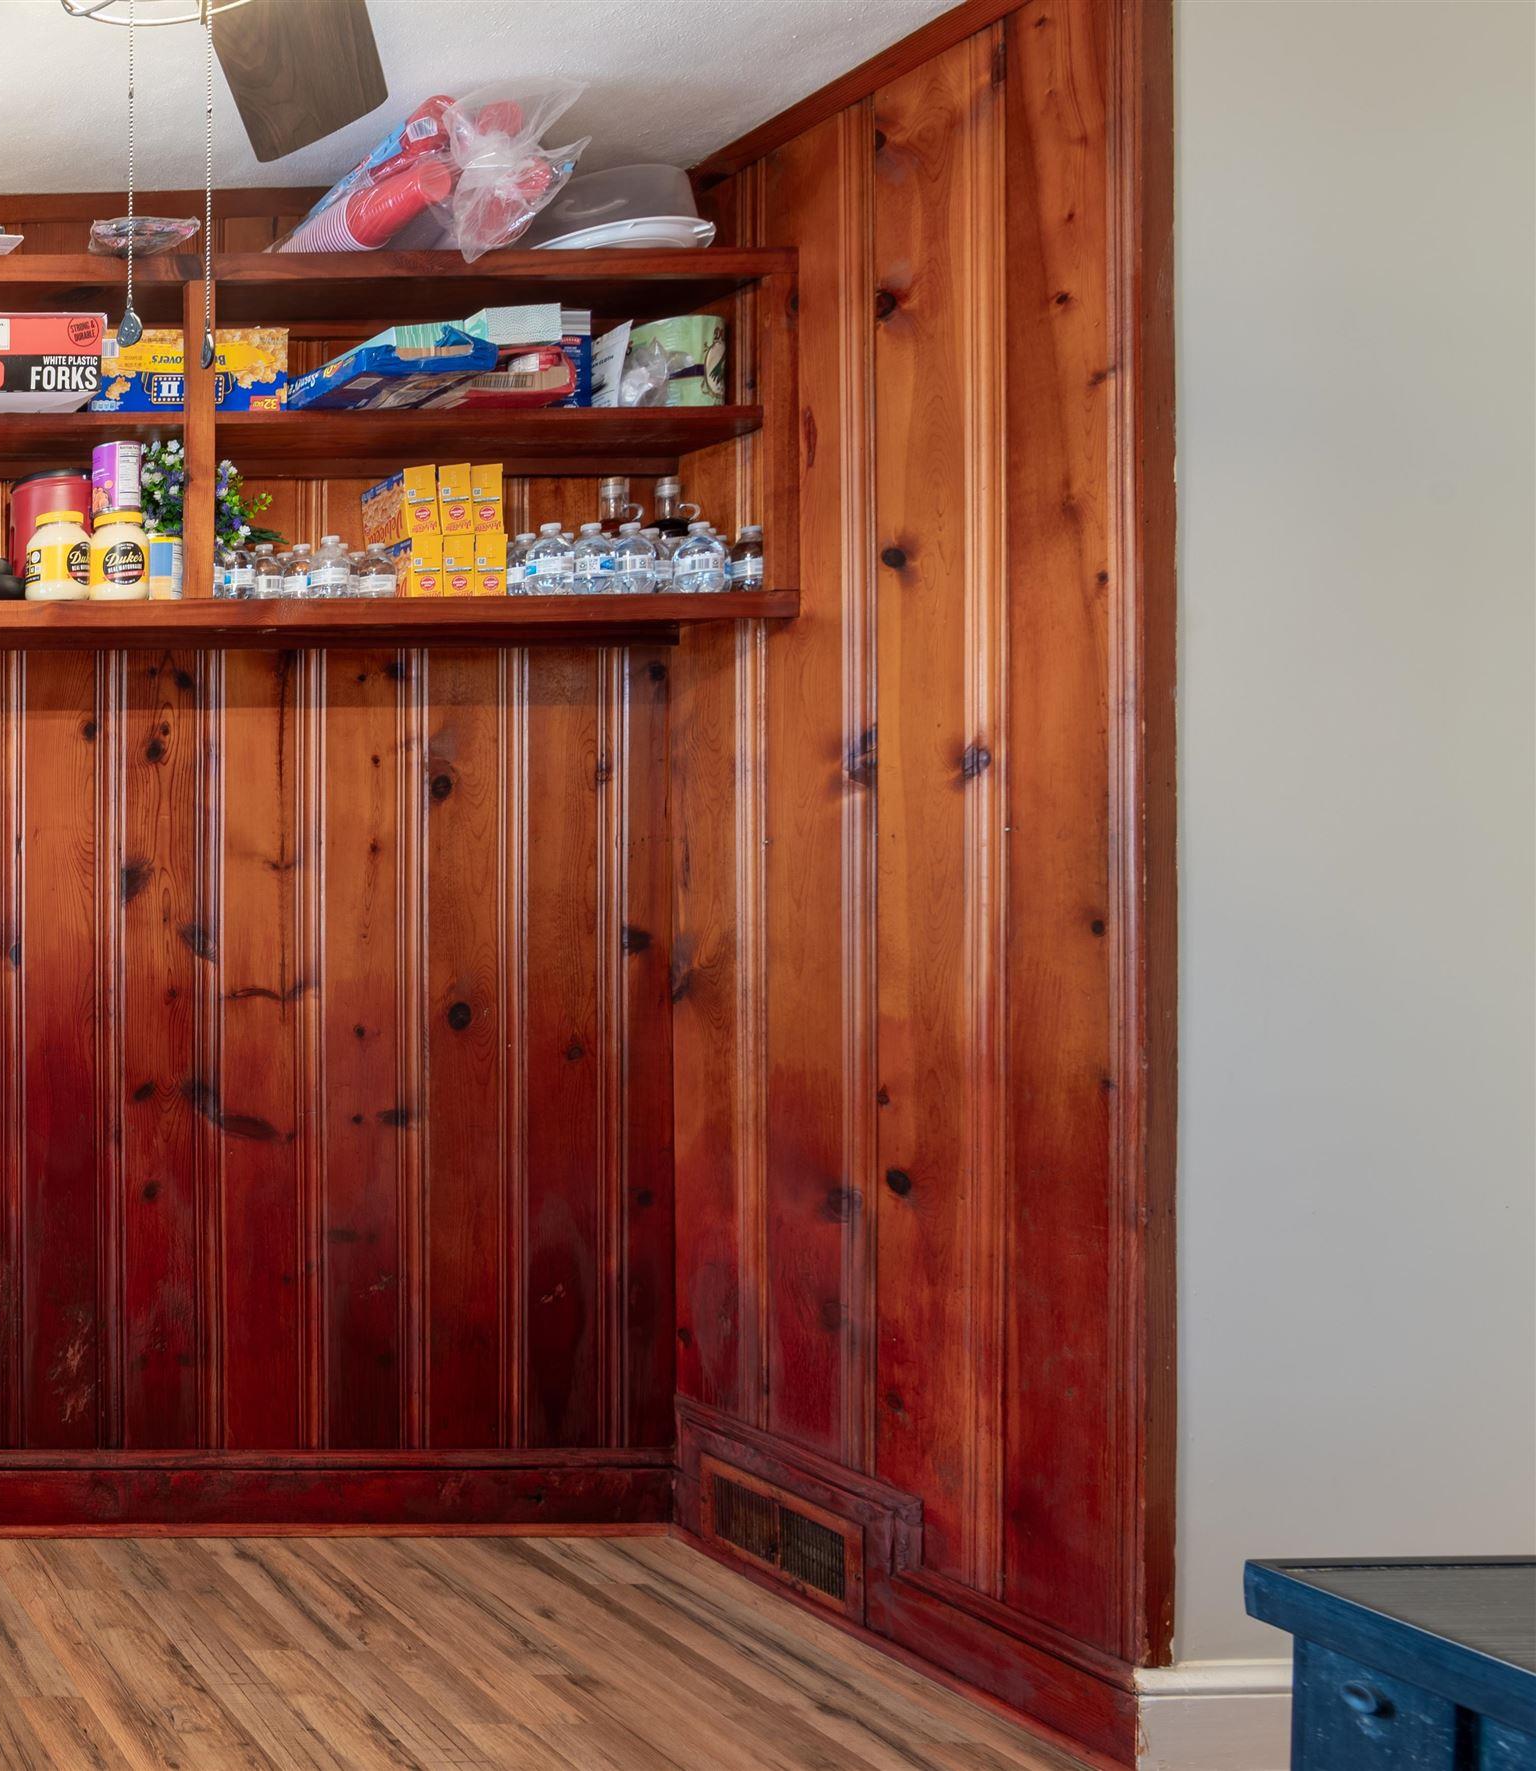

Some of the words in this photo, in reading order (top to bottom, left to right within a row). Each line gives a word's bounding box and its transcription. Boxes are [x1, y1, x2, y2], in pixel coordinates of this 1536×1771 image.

[70, 321, 90, 334] STRONG
[90, 319, 95, 328] &
[74, 329, 96, 342] DURABLE
[43, 356, 67, 366] WHITE
[68, 356, 98, 366] PLASTIC
[30, 366, 98, 390] FORKS
[263, 397, 277, 410] 32
[105, 551, 143, 567] Duke's
